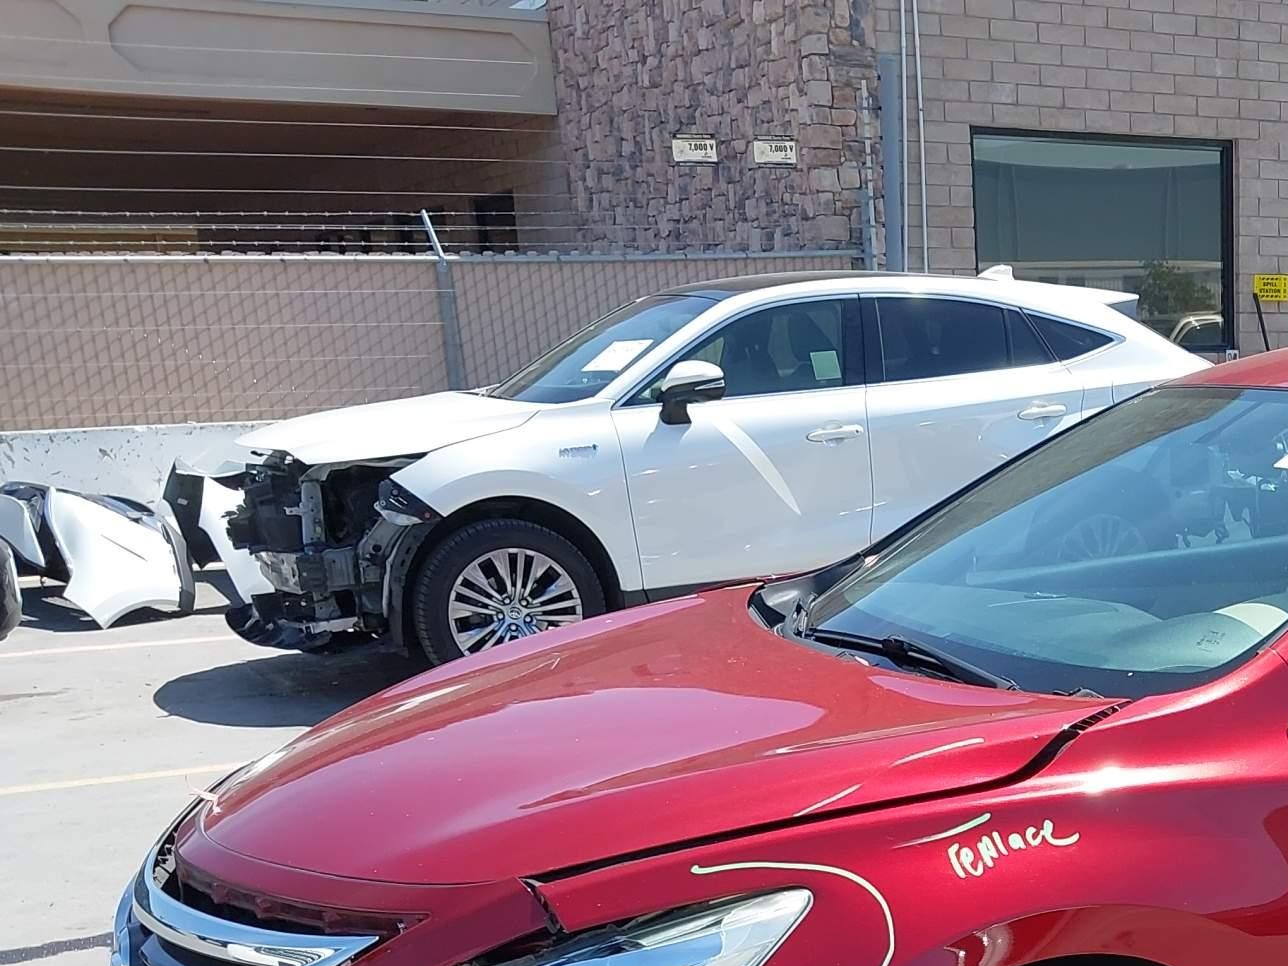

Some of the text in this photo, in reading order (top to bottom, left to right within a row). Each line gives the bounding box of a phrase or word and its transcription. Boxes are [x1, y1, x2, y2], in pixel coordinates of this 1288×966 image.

[687, 143, 715, 152] 7,000 V
[768, 145, 788, 153] 7,000
